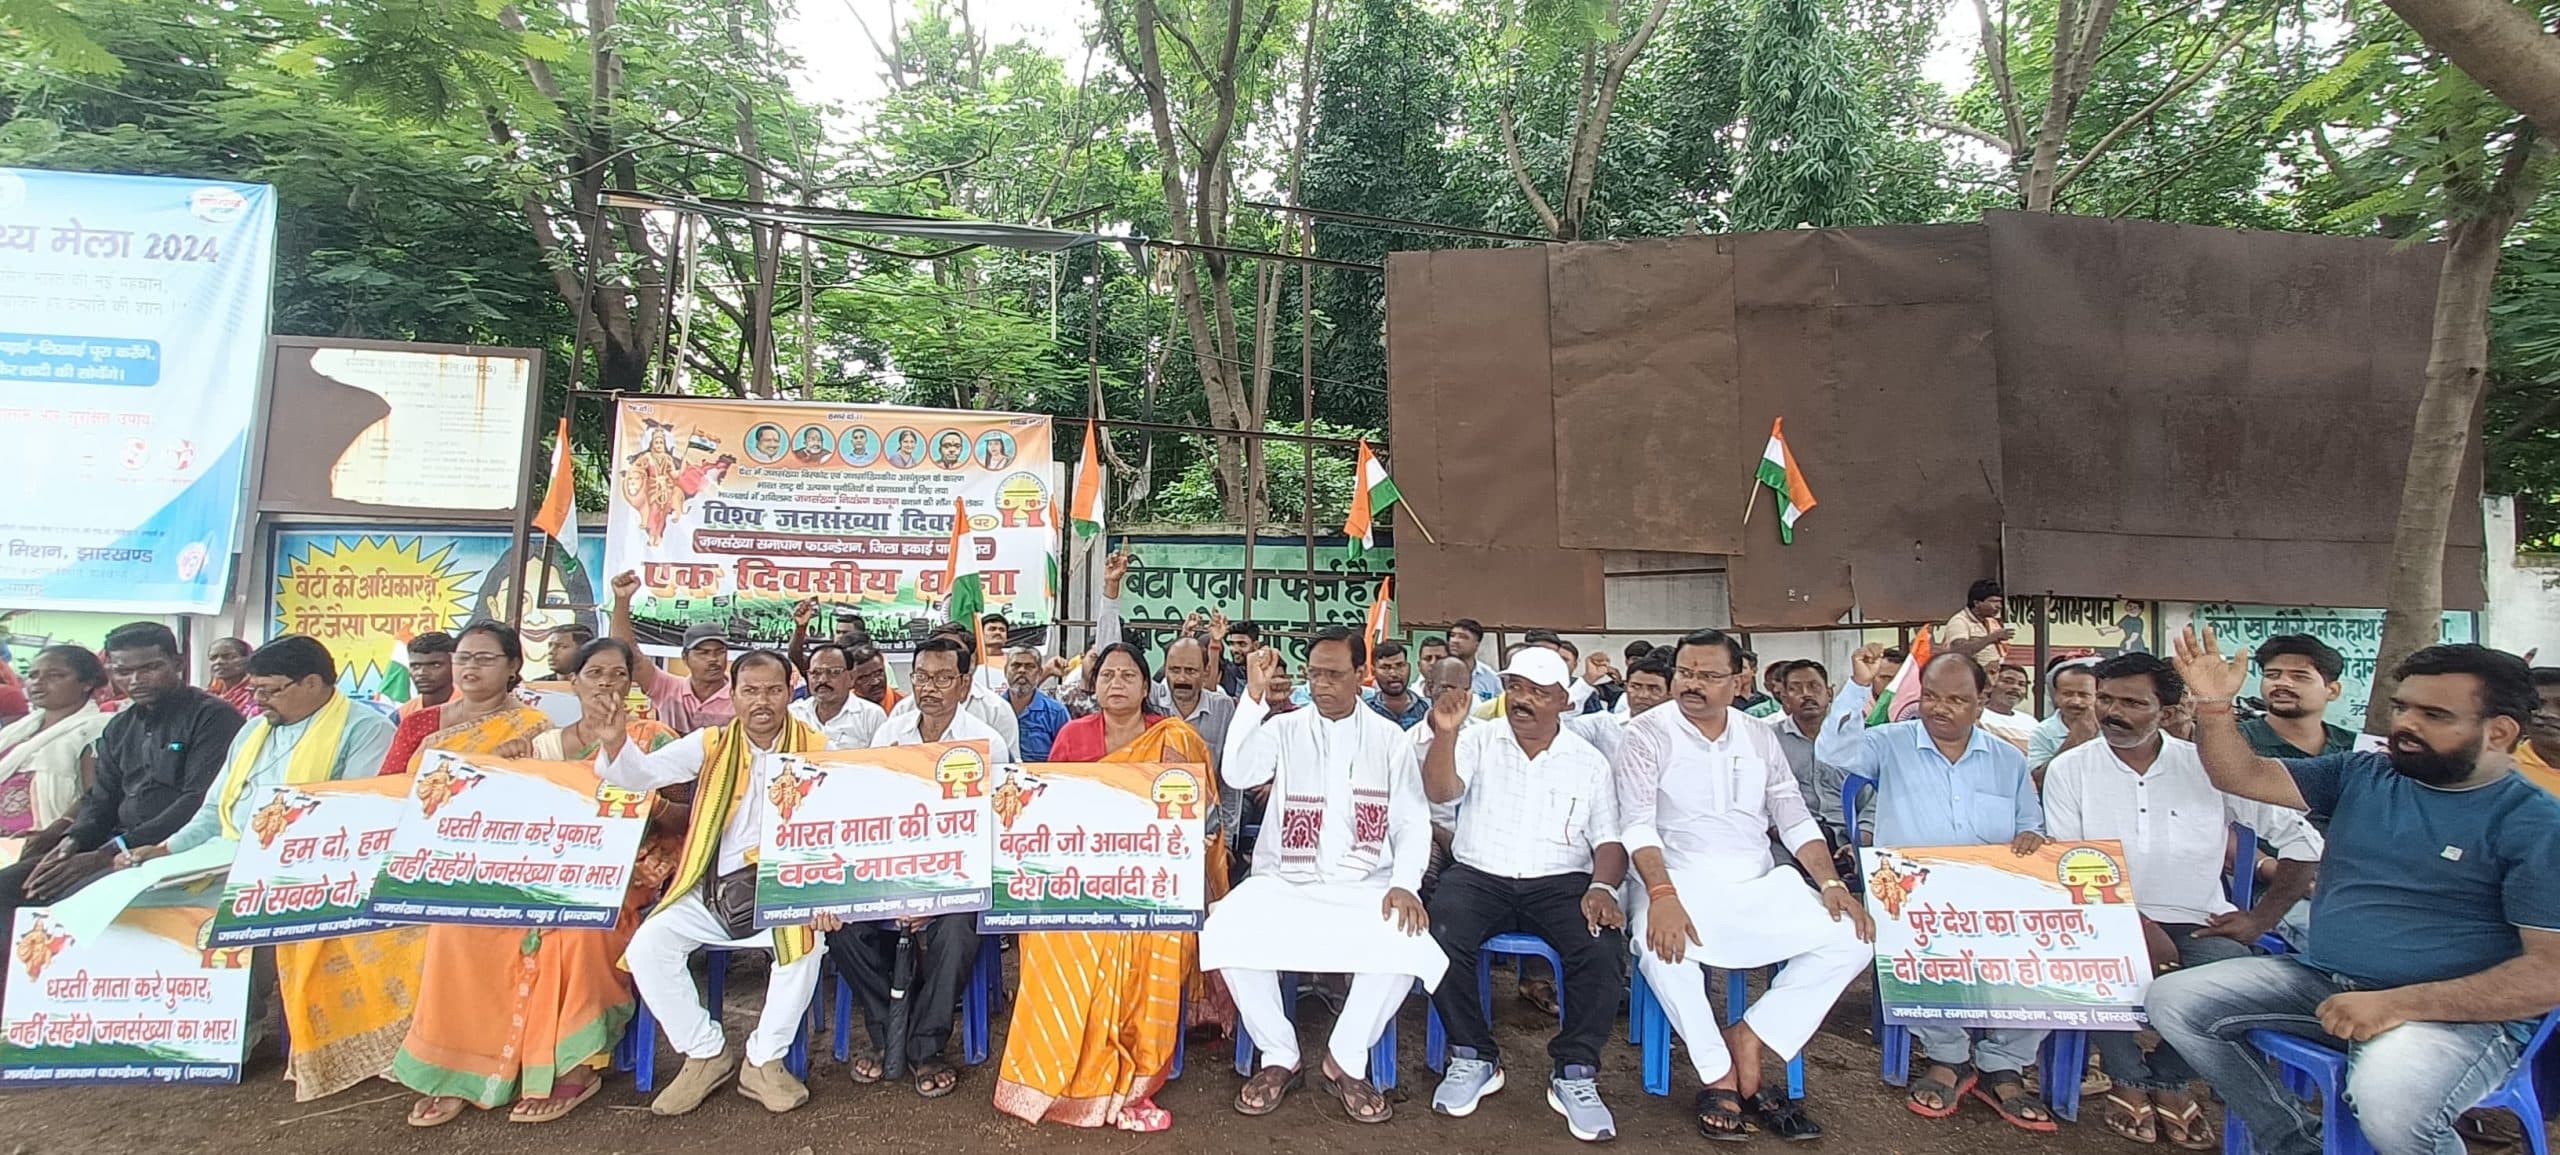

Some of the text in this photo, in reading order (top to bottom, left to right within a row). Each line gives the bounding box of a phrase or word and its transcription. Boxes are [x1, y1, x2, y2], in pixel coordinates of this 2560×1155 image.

[51, 217, 135, 258] मेला
[144, 233, 220, 263] 2024
[764, 469, 799, 477] जनसंख्या
[702, 500, 765, 526] विश्व
[773, 506, 892, 532] जनसंख्या
[974, 518, 989, 527] पर
[794, 494, 836, 504] जनसंख्या
[77, 546, 153, 563] झारखण्ड
[699, 534, 755, 549] जनसंख्या
[757, 538, 803, 551] समाधान
[869, 539, 899, 555] जिला
[902, 539, 933, 557] इकाई
[295, 565, 332, 599] बेटी
[333, 564, 359, 599] को
[357, 566, 425, 601] अधिकार
[641, 557, 1021, 596] एक दिवसीय धना
[1126, 554, 1180, 599] बेटा
[1279, 560, 1343, 602] फर्ज
[1344, 559, 1372, 609] है
[295, 605, 325, 638] बेटे
[324, 602, 368, 640] जैसा
[369, 613, 418, 637] प्यार
[2205, 604, 2242, 644] कैसे
[2344, 618, 2378, 647] हाथ
[437, 811, 602, 853] धरती माता करे पुकार,
[776, 803, 977, 848] भारत माता की जय
[1000, 823, 1190, 861] बढ़ती जो आबादी है,
[280, 826, 397, 864] हम दो, हम
[388, 849, 625, 887] नहीं सहेंगे जनसंख्या का भार।
[779, 850, 970, 885] वन्दे मातरम्
[1009, 865, 1178, 899] देश की बर्बादी है।
[233, 871, 361, 916] तो सबके दो,
[373, 901, 425, 915] जनसंख्या
[763, 906, 811, 920] जनसंख्या
[984, 911, 1027, 926] जनसंख्या
[1907, 902, 2095, 947] पुरे देश का जुनून,
[47, 969, 212, 1009] धरती माता करे पुकार,
[1893, 949, 2137, 997] दो बच्चों का हो कानून।
[9, 1012, 238, 1044] नहीं सहेंगे जनसंख्या का भार।
[1892, 1005, 1942, 1019] जनसंख्या
[2091, 1009, 2150, 1025] (झारखण्ड
